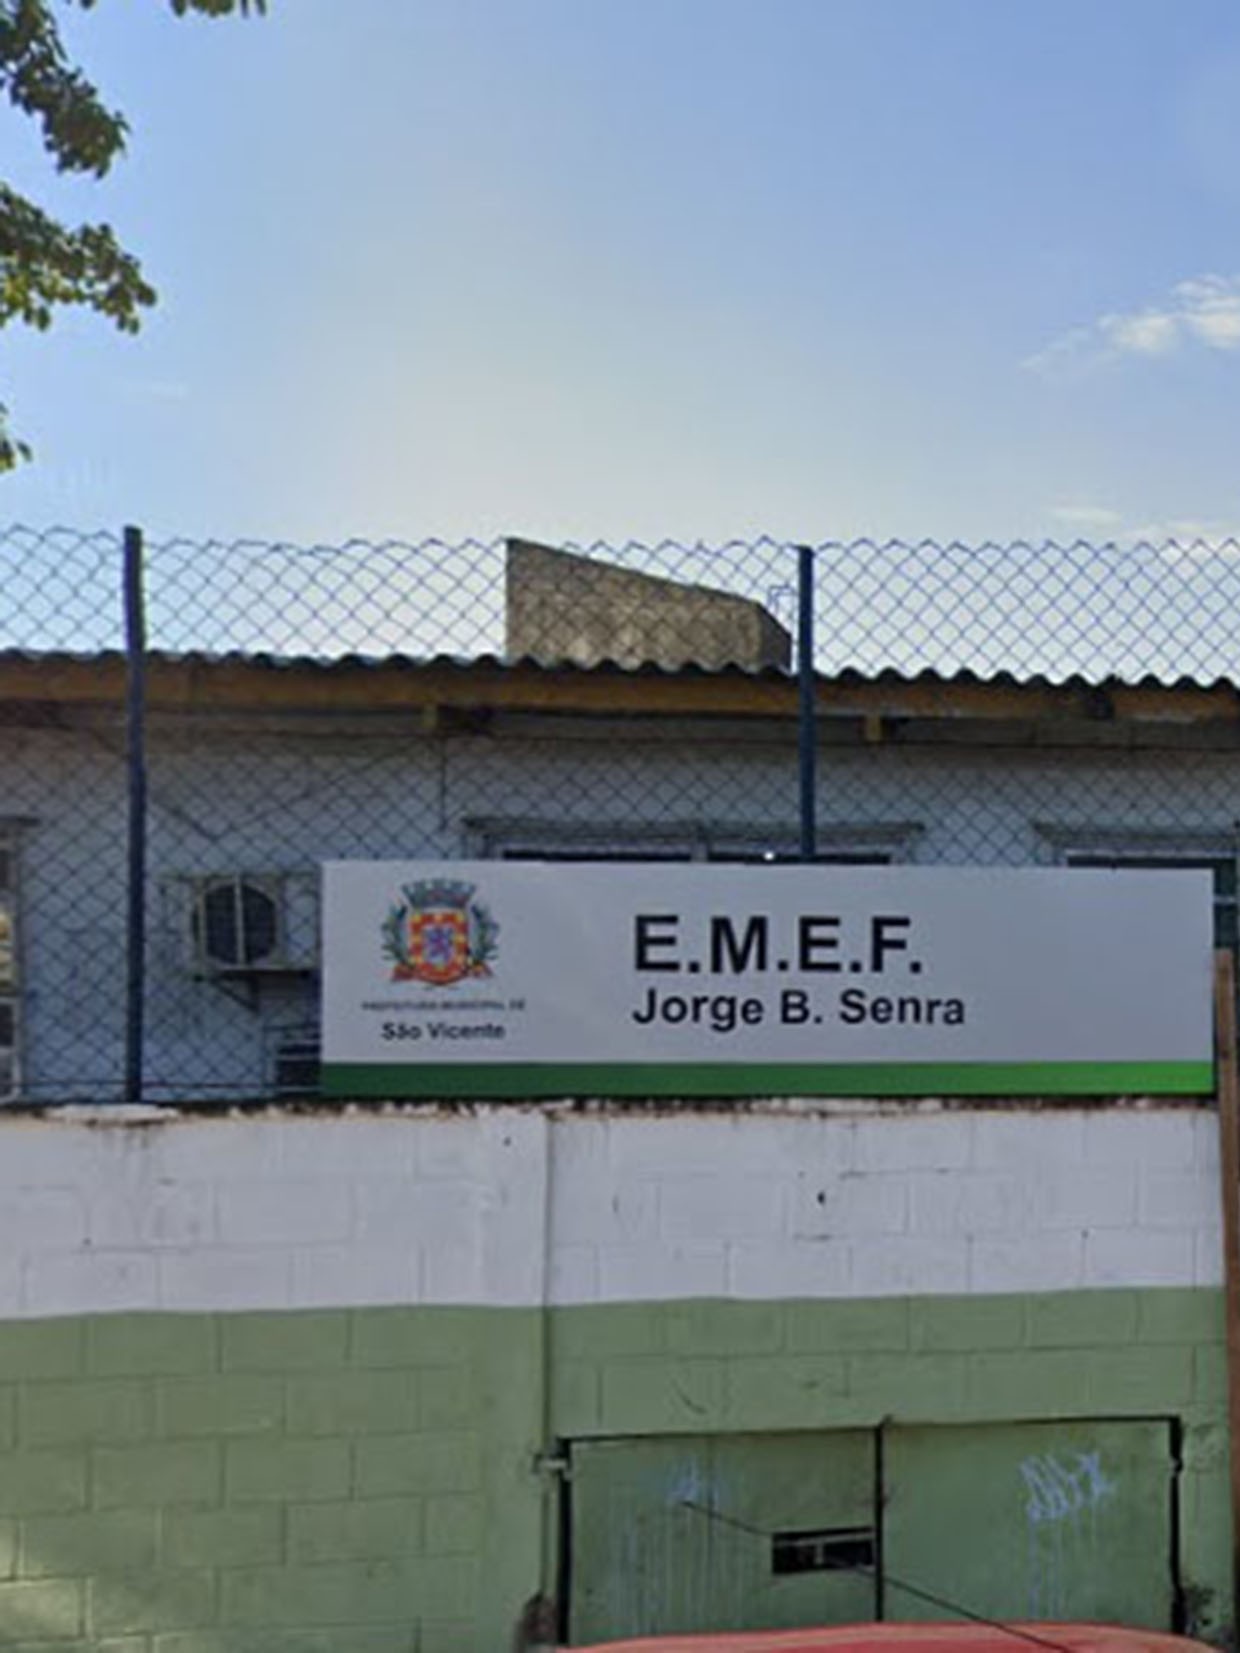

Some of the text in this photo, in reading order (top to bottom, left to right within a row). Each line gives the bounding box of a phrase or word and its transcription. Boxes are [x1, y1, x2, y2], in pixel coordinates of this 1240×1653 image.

[634, 914, 922, 974] E.M.E.F.
[381, 1020, 506, 1040] São Vicente
[632, 987, 965, 1032] Jorge B. Senra
